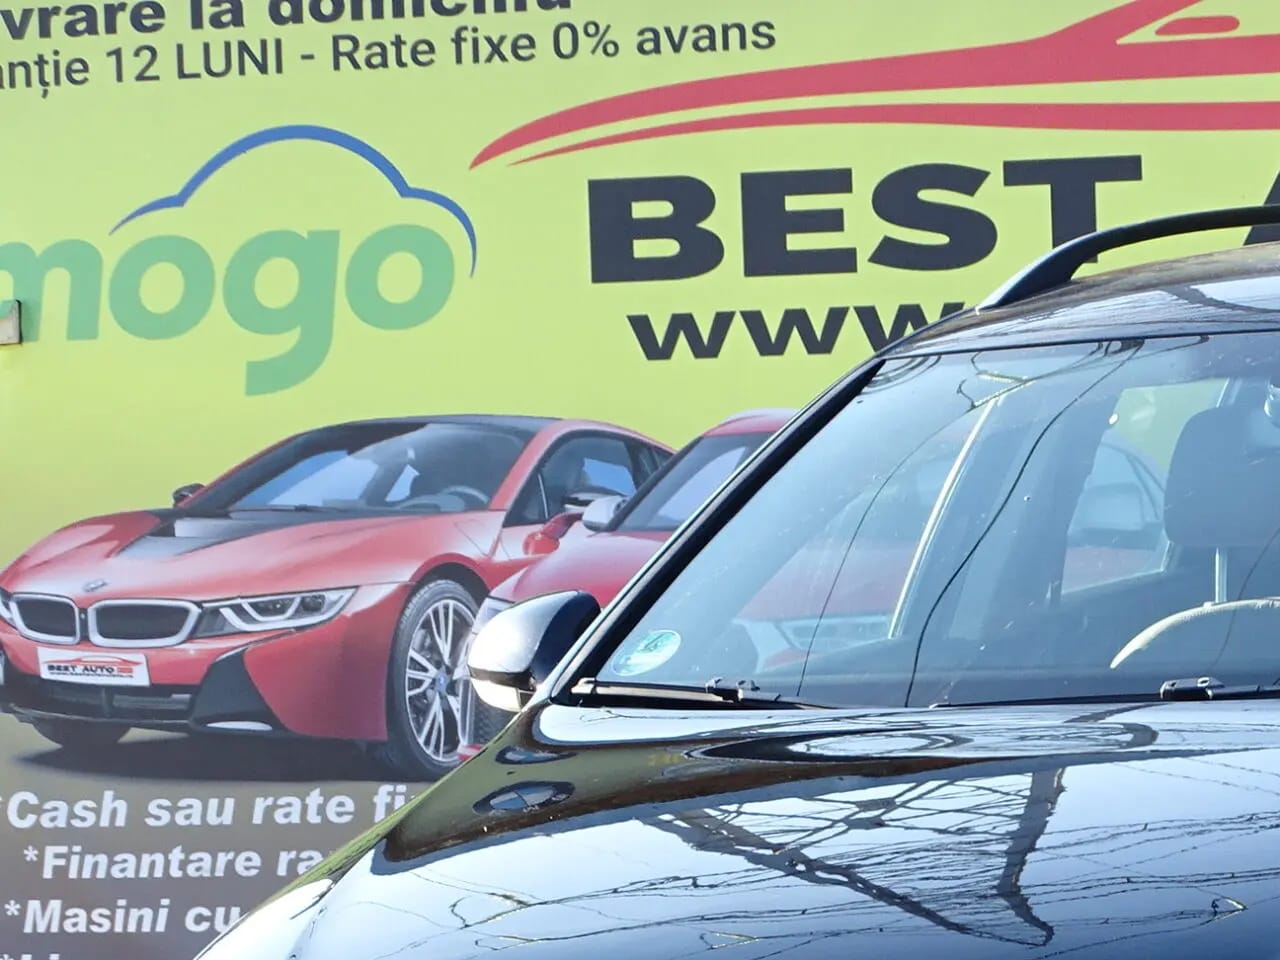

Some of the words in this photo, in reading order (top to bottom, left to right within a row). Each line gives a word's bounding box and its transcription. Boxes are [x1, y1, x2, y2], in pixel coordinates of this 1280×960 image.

[190, 0, 245, 30] la
[0, 49, 90, 98] nție
[106, 45, 160, 83] 12
[176, 38, 283, 80] LUNI
[331, 34, 436, 71] Rate
[450, 25, 536, 65] fixe
[553, 20, 620, 60] 0%
[636, 20, 776, 55] avans
[587, 154, 1142, 284] BEST
[0, 223, 456, 397] mogo
[6, 790, 129, 828] Cash
[144, 796, 236, 827] sau
[252, 787, 356, 825] rate
[184, 905, 241, 934] cu
